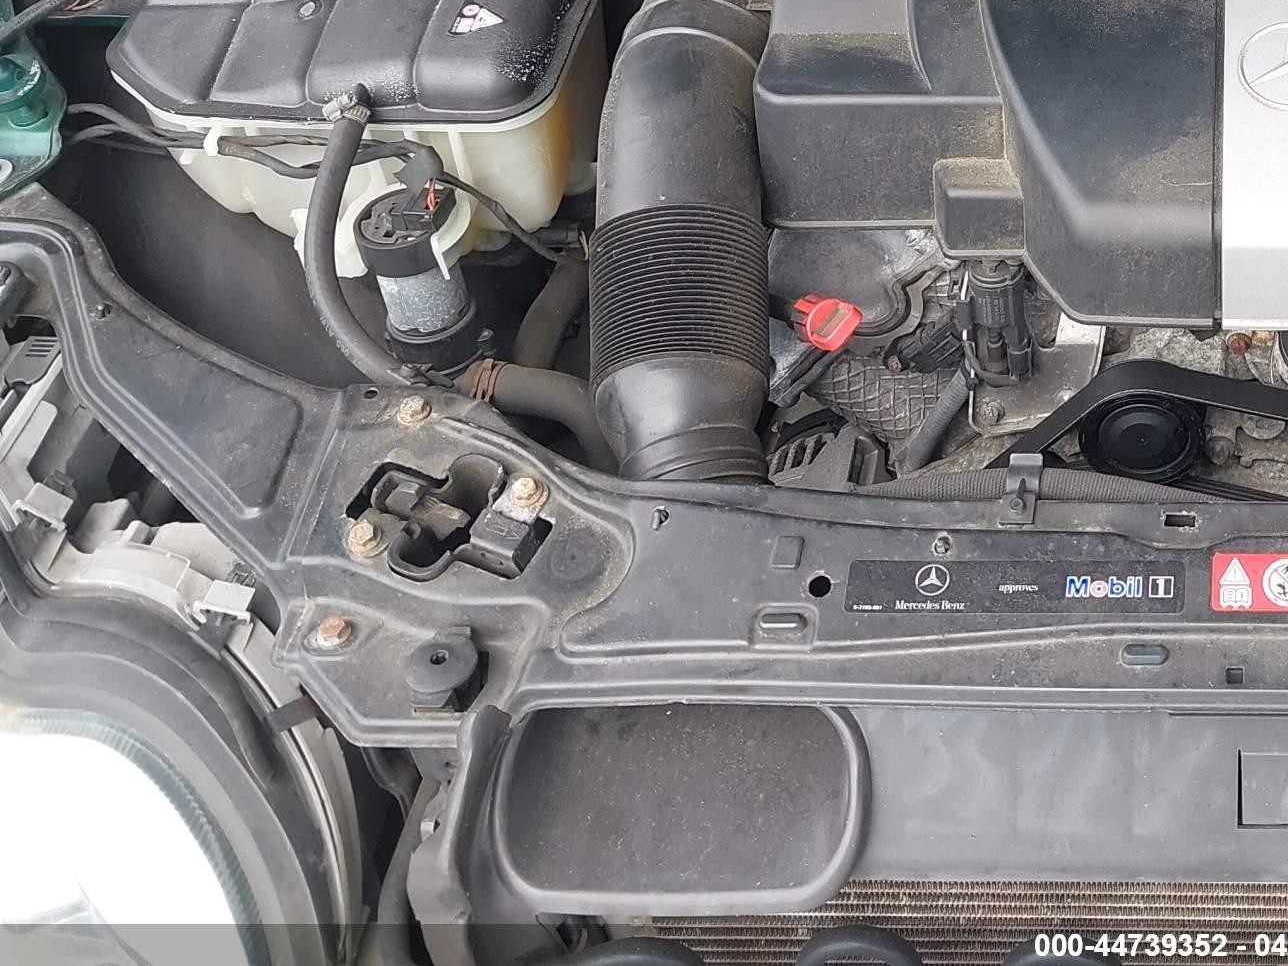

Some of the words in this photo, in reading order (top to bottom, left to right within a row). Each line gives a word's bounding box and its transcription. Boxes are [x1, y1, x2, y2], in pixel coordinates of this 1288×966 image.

[998, 583, 1039, 593] approves
[1065, 576, 1143, 598] Mobil
[895, 600, 940, 611] Mercedes
[941, 600, 965, 611] Benz
